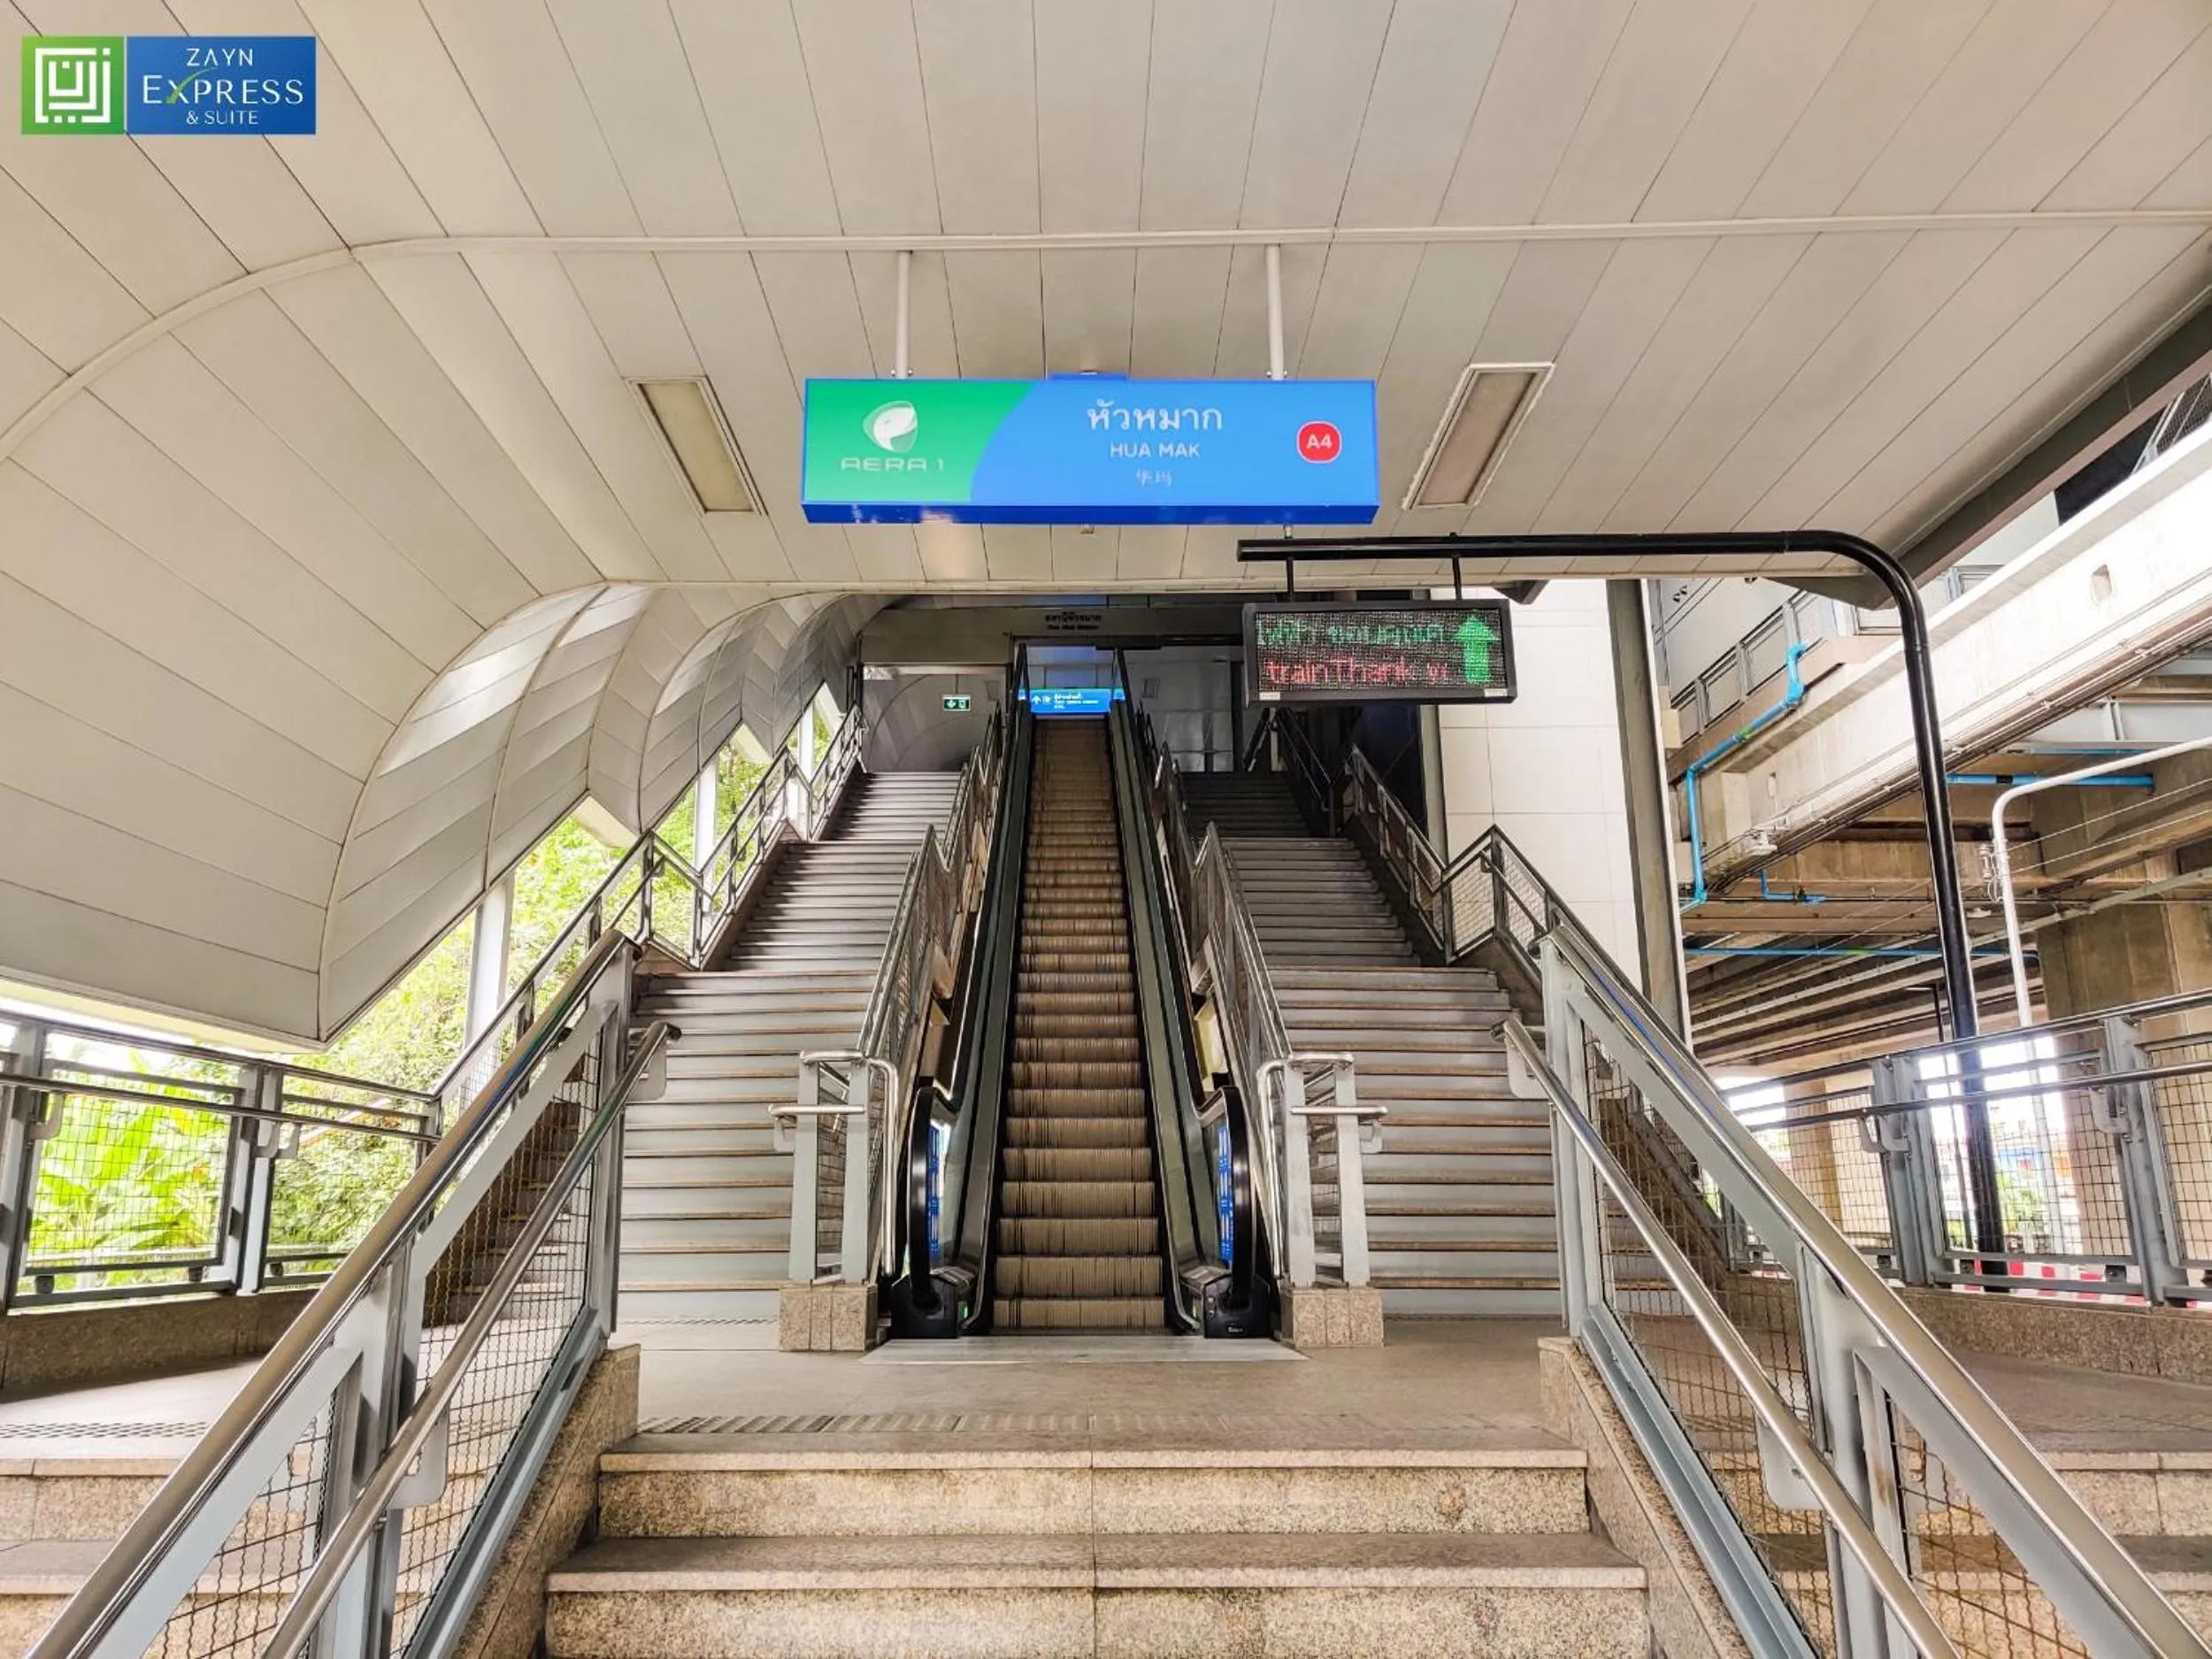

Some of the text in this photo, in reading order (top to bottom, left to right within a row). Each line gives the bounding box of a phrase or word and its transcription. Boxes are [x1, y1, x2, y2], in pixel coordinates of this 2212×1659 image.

[1087, 398, 1223, 431] หัวหมาก
[1306, 433, 1333, 449] A4
[1110, 442, 1201, 458] HUA MAK
[841, 457, 945, 472] AERA 1
